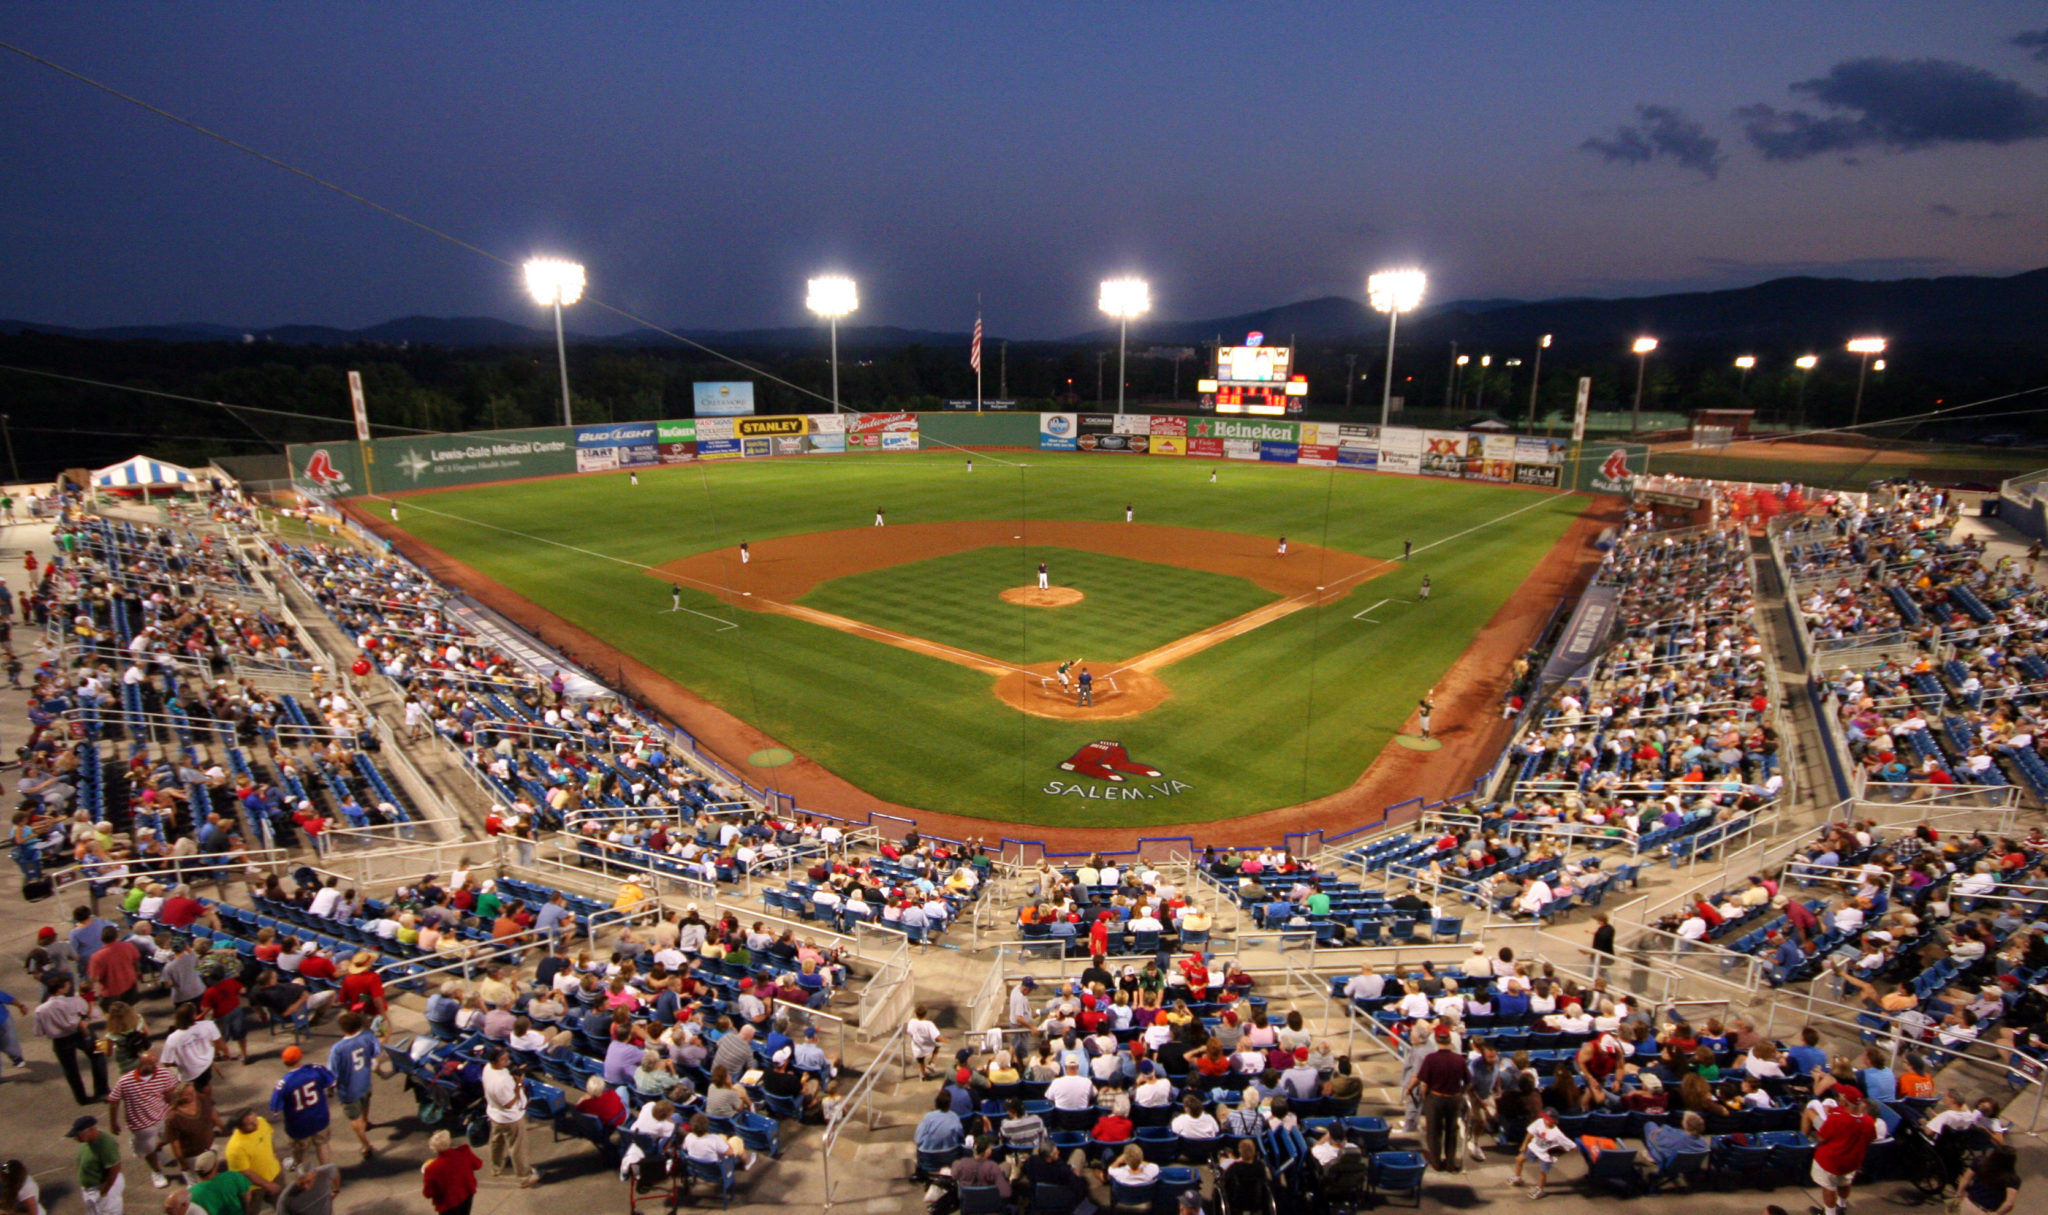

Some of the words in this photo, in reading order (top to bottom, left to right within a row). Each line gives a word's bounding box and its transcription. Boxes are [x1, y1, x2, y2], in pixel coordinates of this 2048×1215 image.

[743, 421, 798, 433] STANLEY
[850, 413, 907, 433] Budweiser
[1213, 421, 1293, 441] Heineken
[578, 432, 610, 442] BUD
[615, 429, 654, 441] LIGHT
[430, 446, 490, 462] Lewis-Gale
[491, 441, 531, 456] Medical
[532, 440, 566, 453] Center
[1150, 779, 1194, 797] VA
[351, 1047, 365, 1071] 5
[293, 1081, 319, 1112] 15
